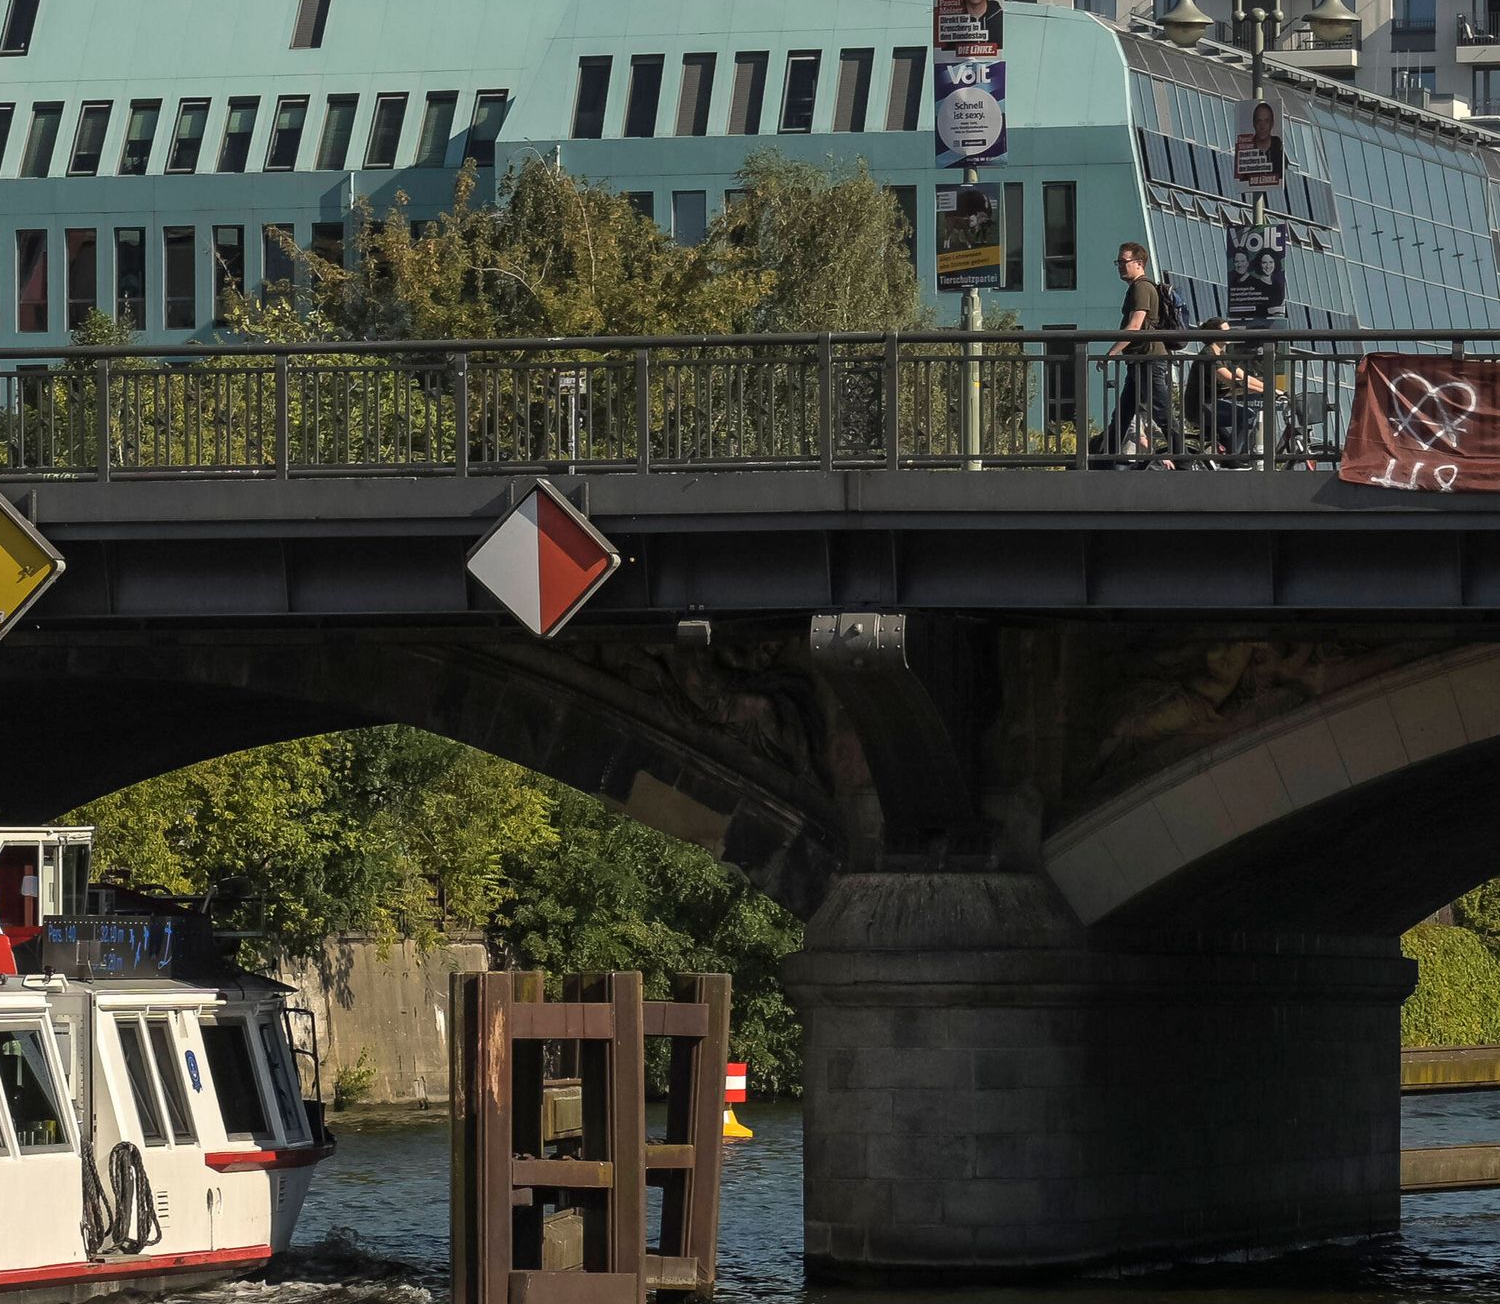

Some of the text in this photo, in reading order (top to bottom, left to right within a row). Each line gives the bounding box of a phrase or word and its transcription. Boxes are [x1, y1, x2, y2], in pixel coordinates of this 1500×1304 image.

[946, 64, 991, 85] Volt
[954, 101, 984, 110] Schnell
[953, 111, 985, 121] ist sexy.
[1229, 227, 1283, 252] Volt
[940, 274, 998, 285] Tierschutzpartei
